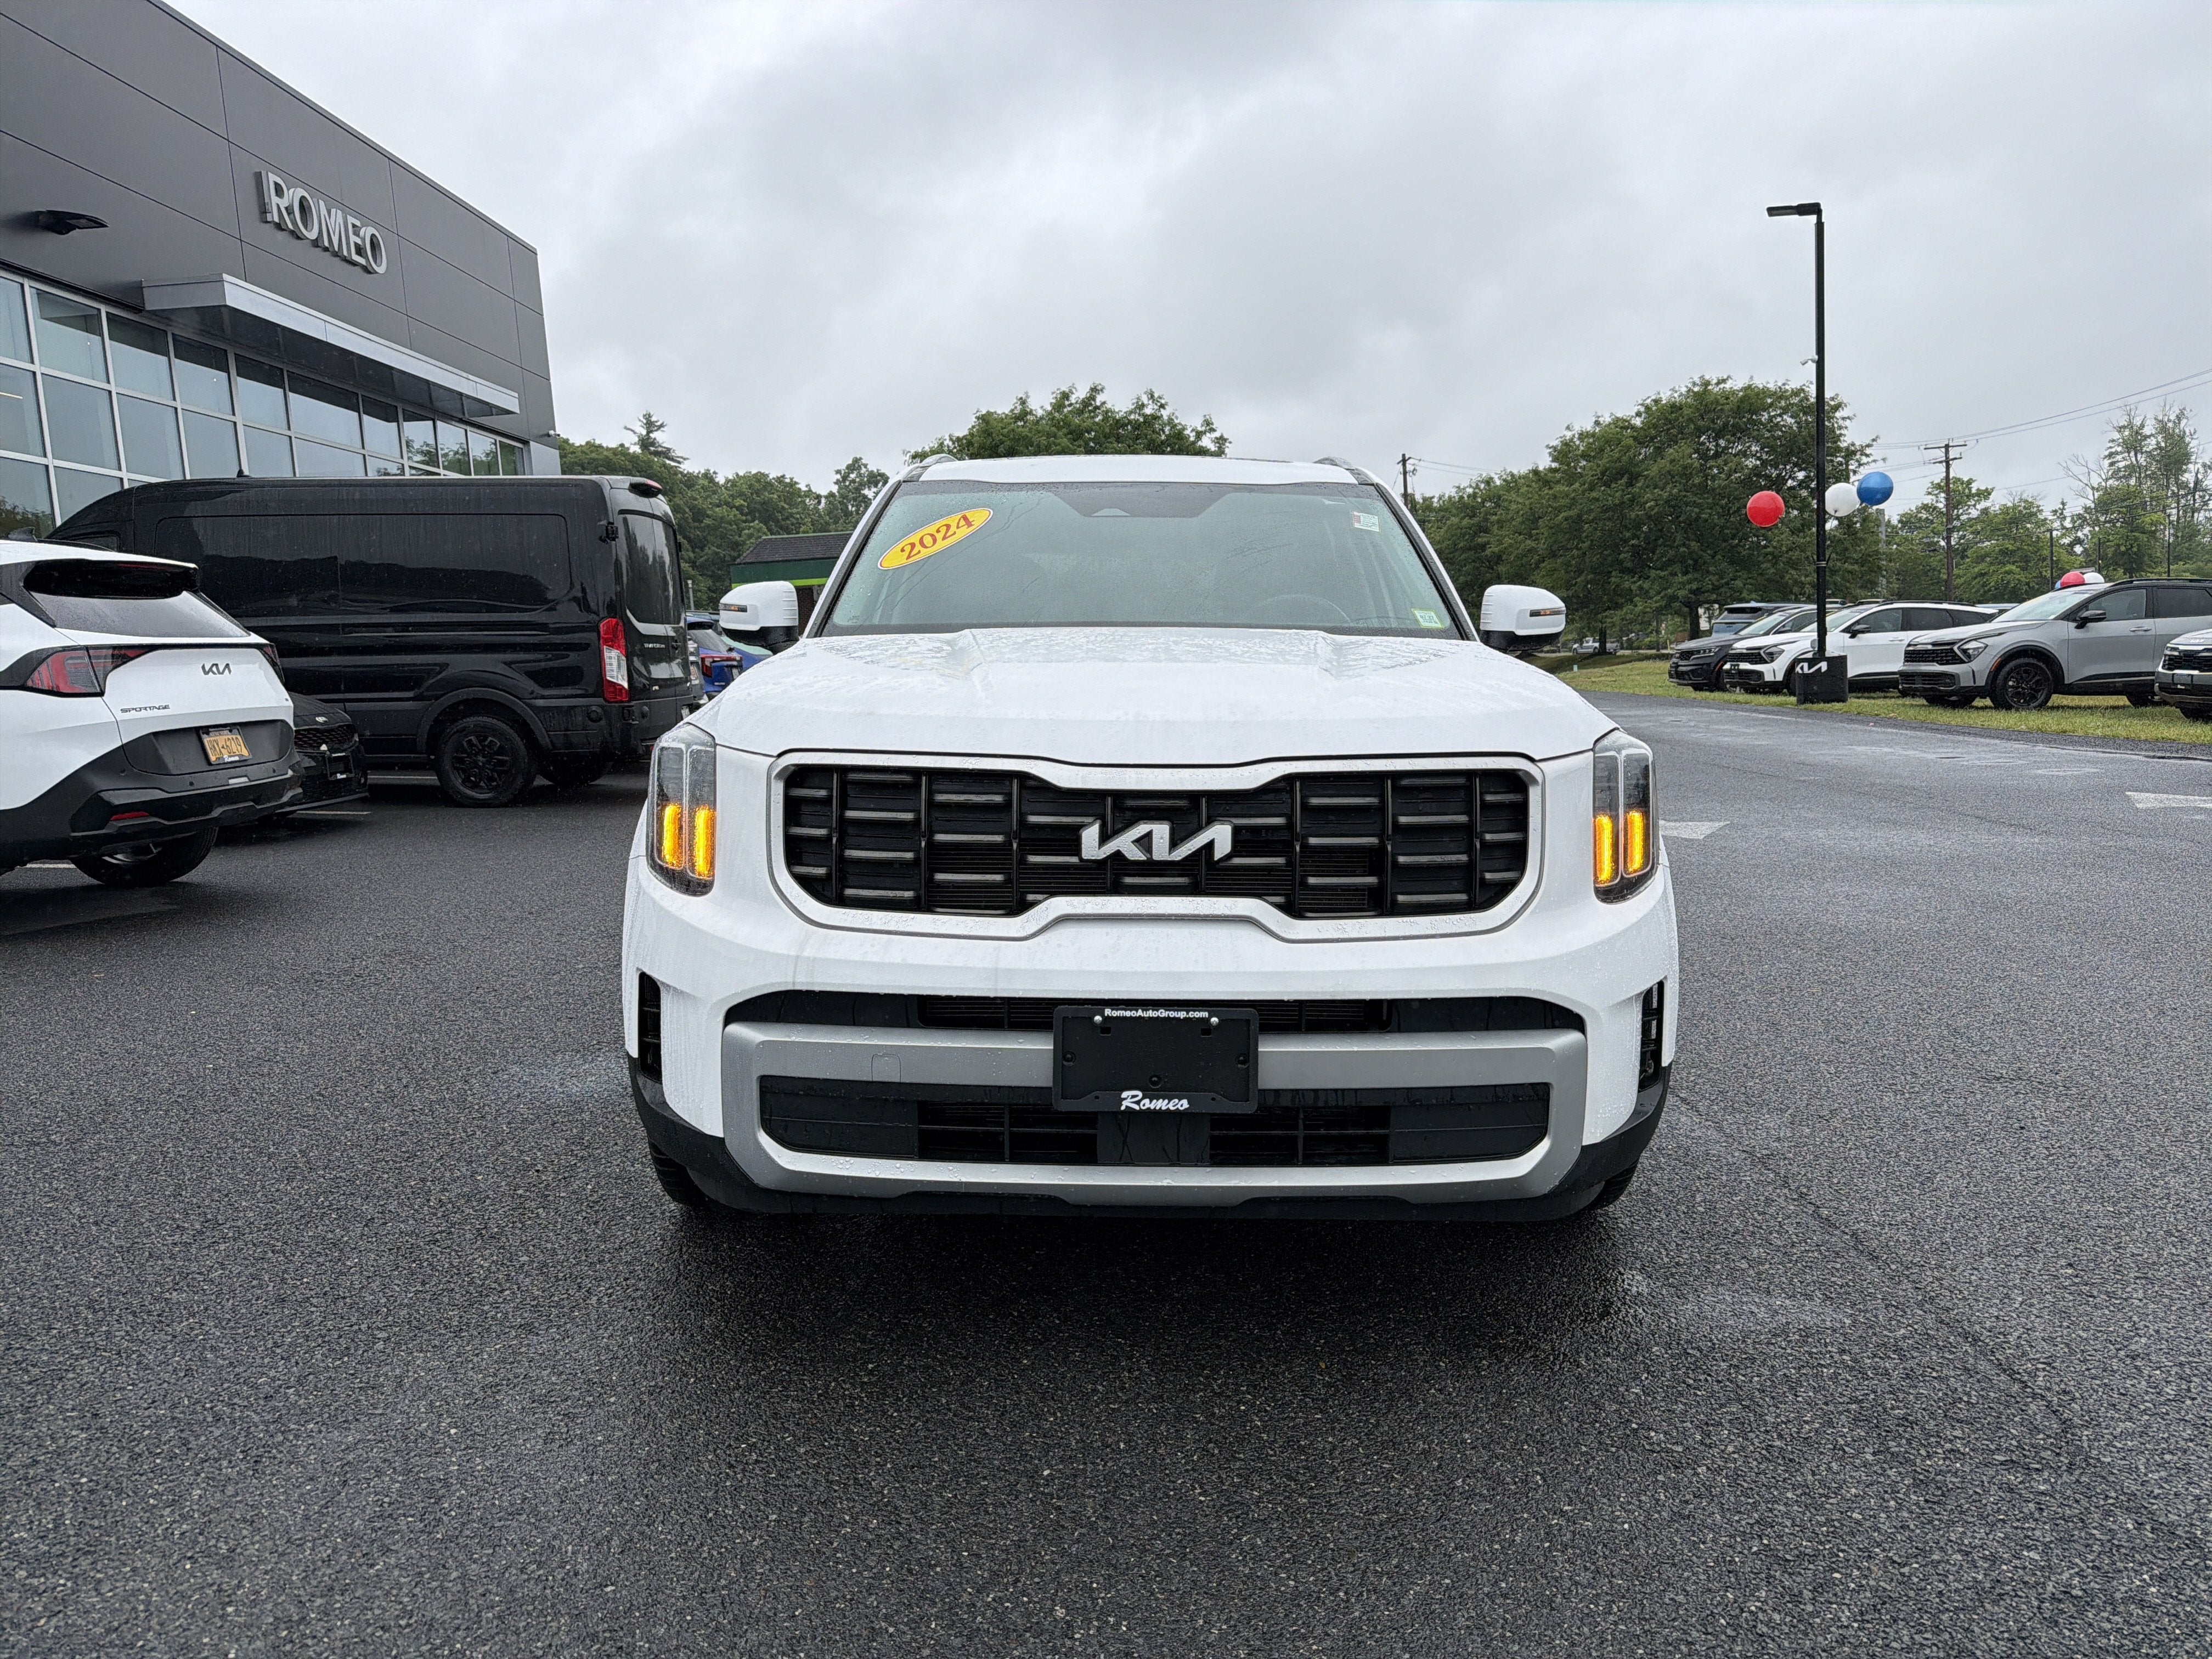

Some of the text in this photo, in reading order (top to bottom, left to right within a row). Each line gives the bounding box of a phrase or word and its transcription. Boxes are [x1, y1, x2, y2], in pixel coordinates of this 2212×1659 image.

[263, 171, 387, 274] ROMEO
[900, 514, 975, 561] 2024
[201, 663, 232, 675] KIA
[1795, 661, 1828, 674] KIA
[120, 704, 171, 713] SPORTAGE
[1081, 821, 1232, 861] KIA
[1104, 1008, 1209, 1019] RomeoAutoGroup.com
[1120, 1090, 1190, 1111] Romeo
